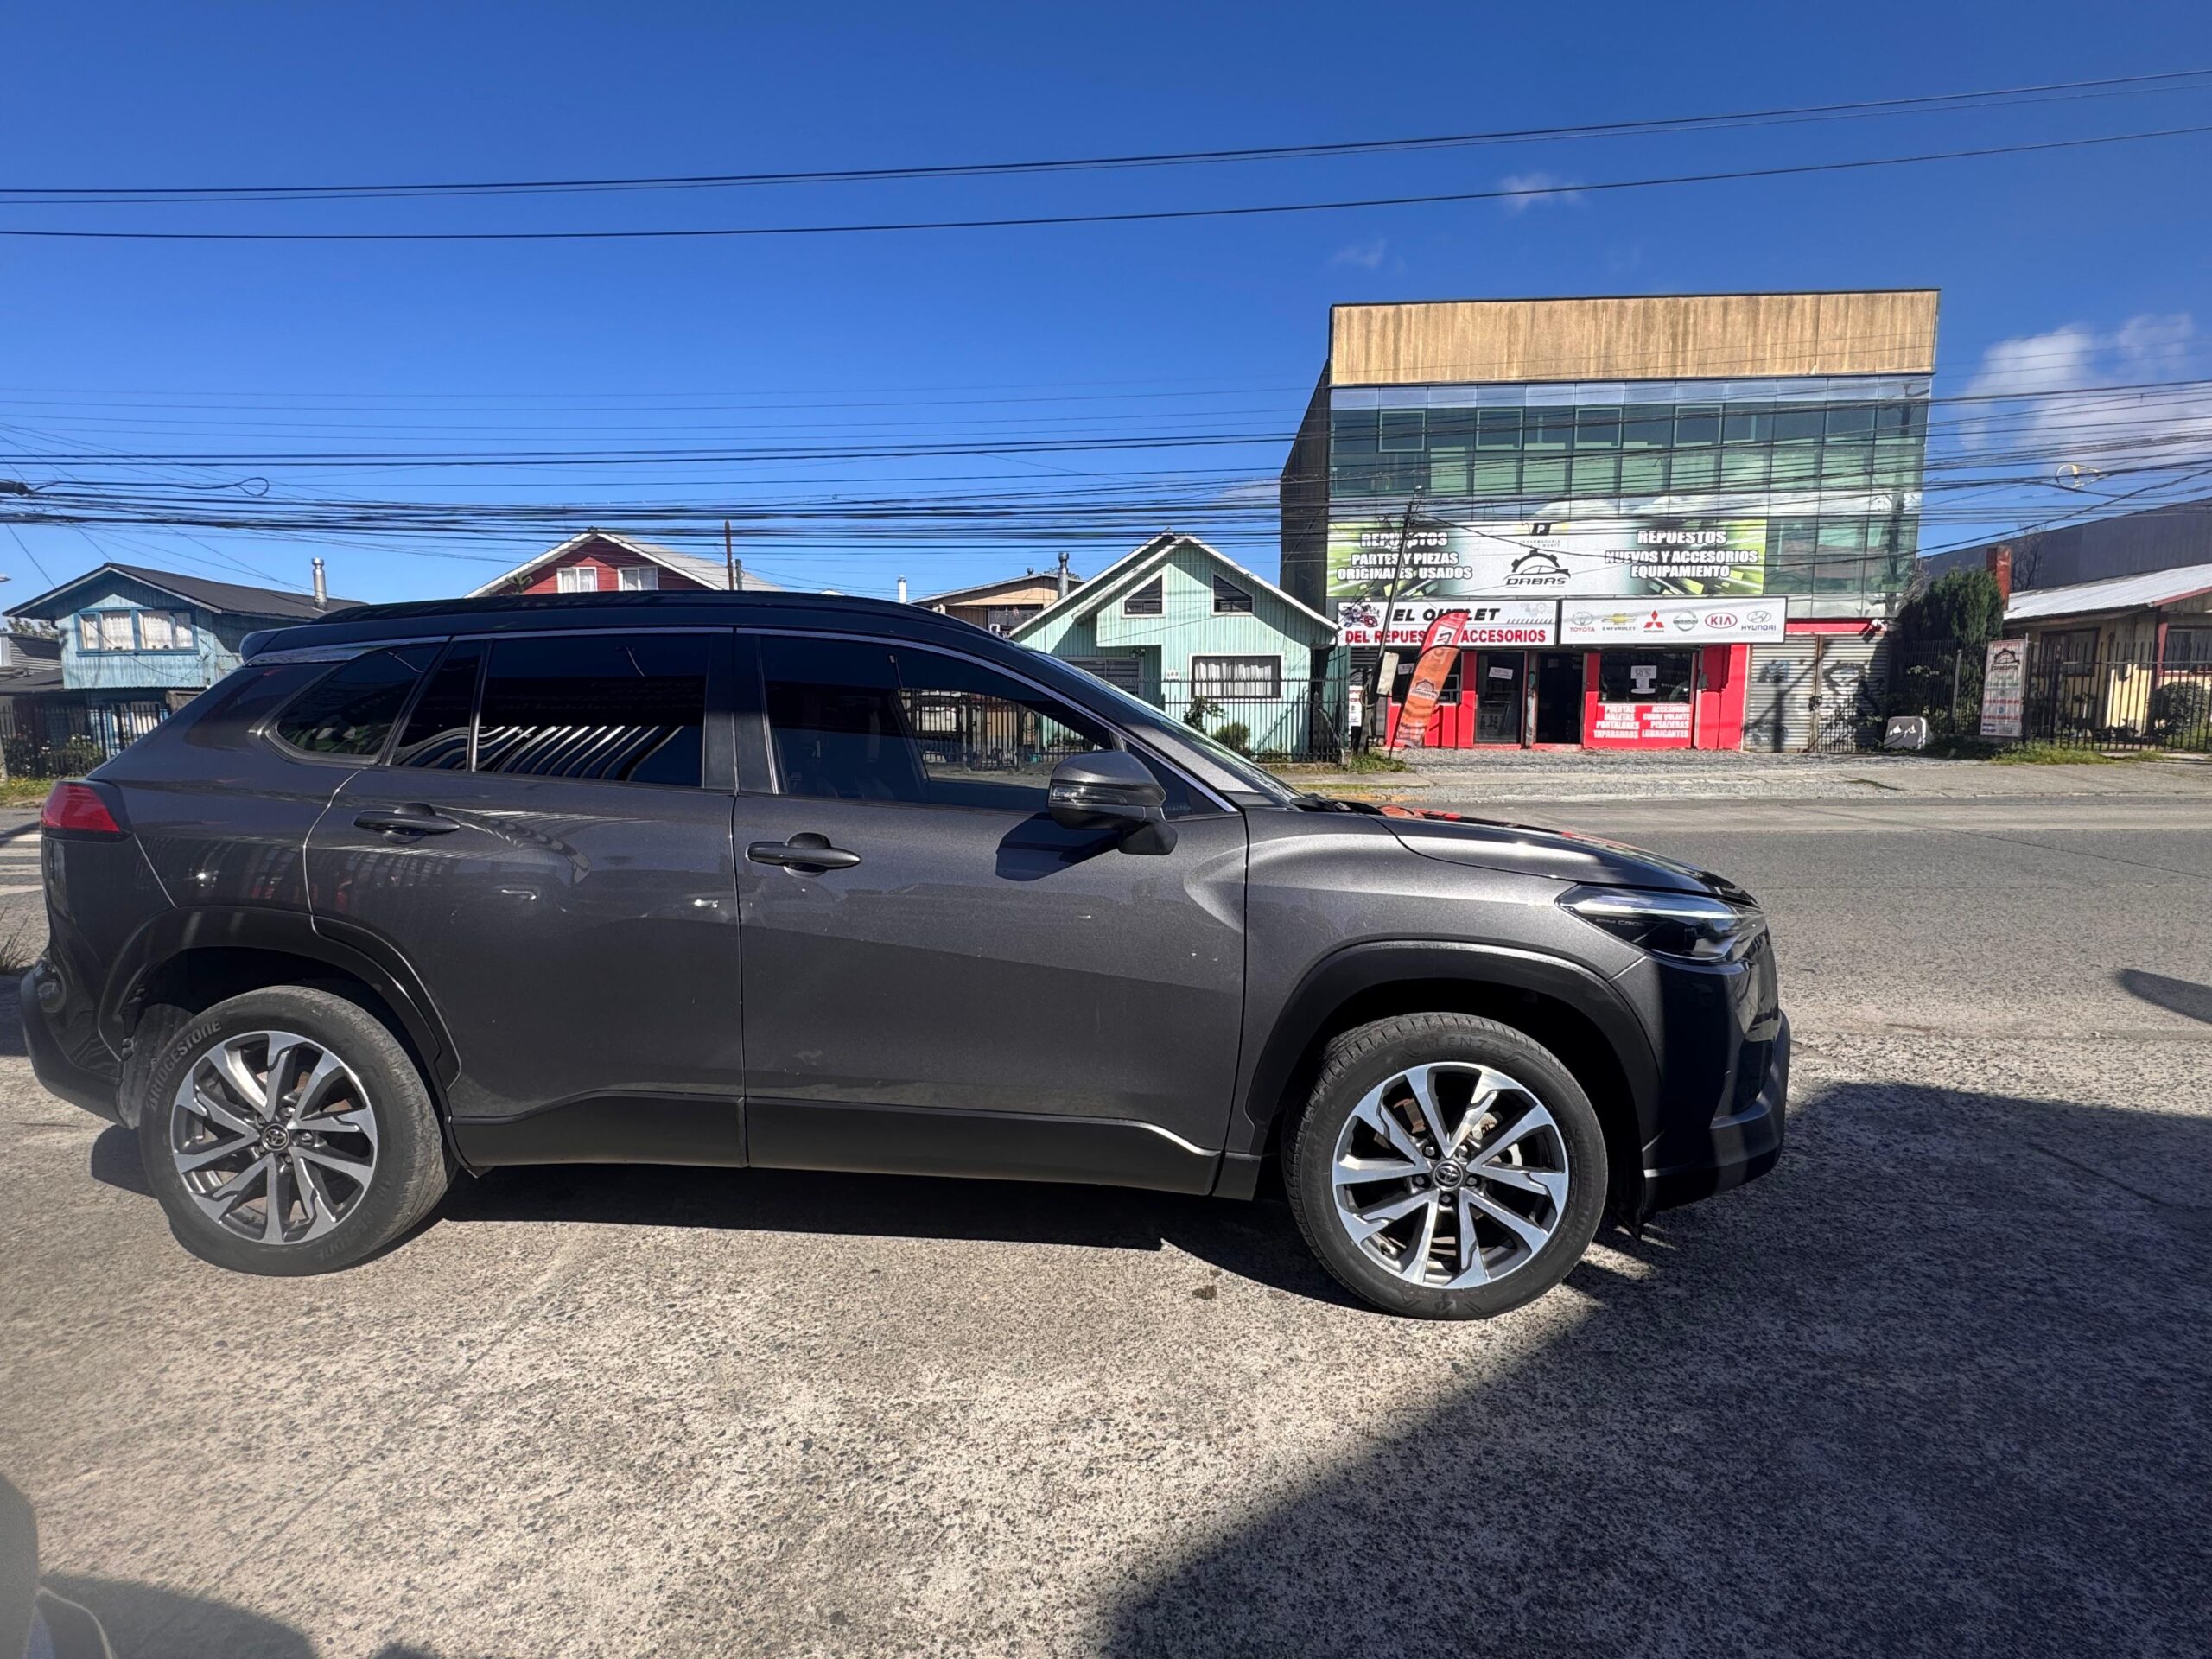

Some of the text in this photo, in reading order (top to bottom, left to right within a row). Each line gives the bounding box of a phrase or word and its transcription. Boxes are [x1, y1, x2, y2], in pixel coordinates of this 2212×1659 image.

[1361, 532, 1448, 547] REPUSTOS
[1637, 531, 1726, 544] REPUESTOS
[1351, 553, 1459, 566] PARTES Y PIEZAS
[1605, 550, 1758, 563] NUEVOS Y ACCESORIOS
[1418, 567, 1473, 579] USADOS
[1630, 565, 1731, 578] EQUIPAMIENTO
[1506, 577, 1567, 586] DABAS
[1393, 608, 1501, 622] EL OET
[1711, 616, 1732, 626] KIA
[1345, 631, 1370, 643] DEL
[1460, 629, 1546, 643] ACCESORIOS
[145, 1020, 222, 1111] BRIDGESTONE
